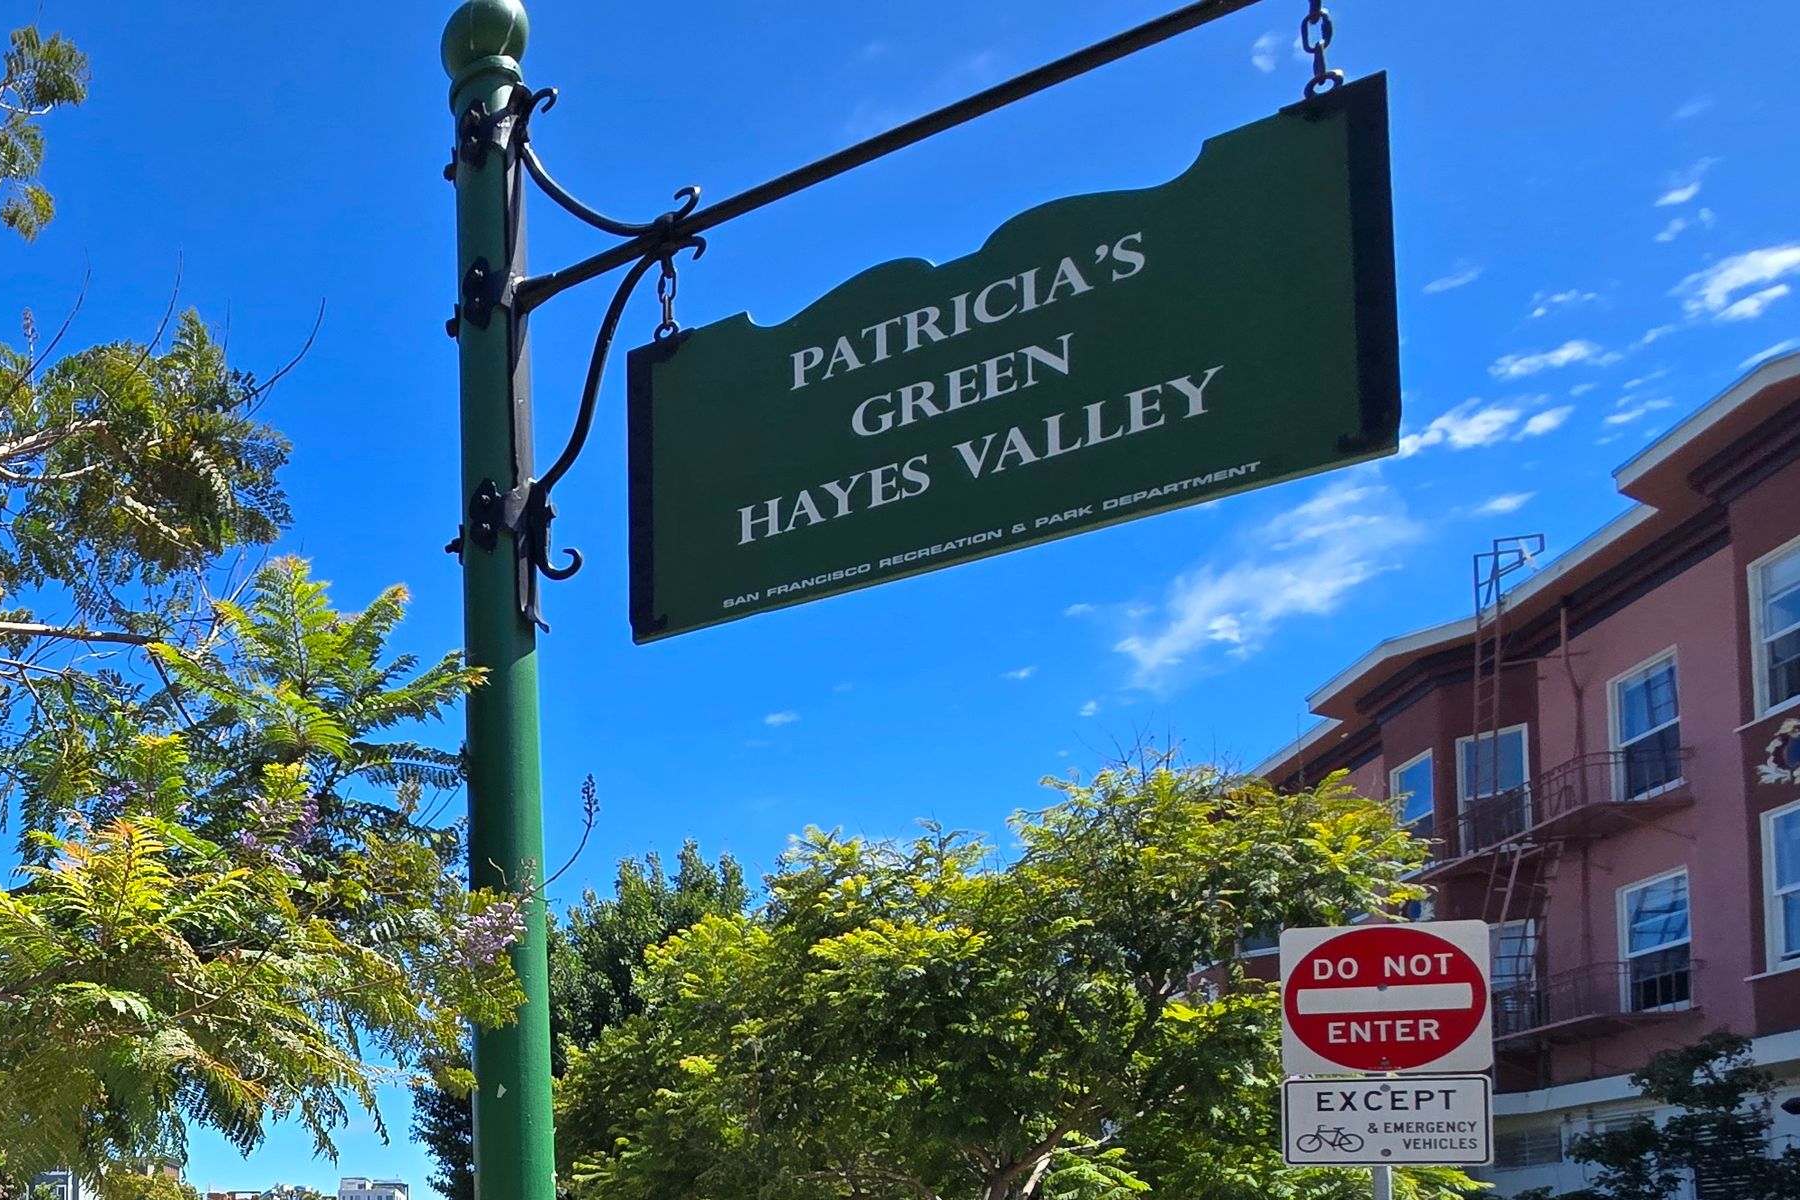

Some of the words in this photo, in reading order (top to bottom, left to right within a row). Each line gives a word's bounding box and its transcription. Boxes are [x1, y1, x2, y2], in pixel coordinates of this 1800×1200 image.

[788, 231, 1146, 391] PATRICIA'S
[850, 332, 1076, 437] GREEN
[736, 453, 932, 546] HAYES
[951, 364, 1226, 480] VALLEY
[722, 591, 760, 609] SAN
[766, 563, 872, 598] FRANCISCO
[878, 528, 1004, 569] RECREATION
[1011, 522, 1027, 535] &
[1034, 504, 1094, 529] PARK
[1102, 460, 1262, 511] DEPARTMENT
[1312, 957, 1359, 981] DO
[1383, 952, 1454, 978] NOT
[1327, 1018, 1441, 1044] ENTER
[1315, 1088, 1457, 1113] EXCEPT
[1367, 1122, 1379, 1134] &
[1383, 1120, 1478, 1134] EMERGENCY
[1402, 1137, 1478, 1151] VEHICLES
